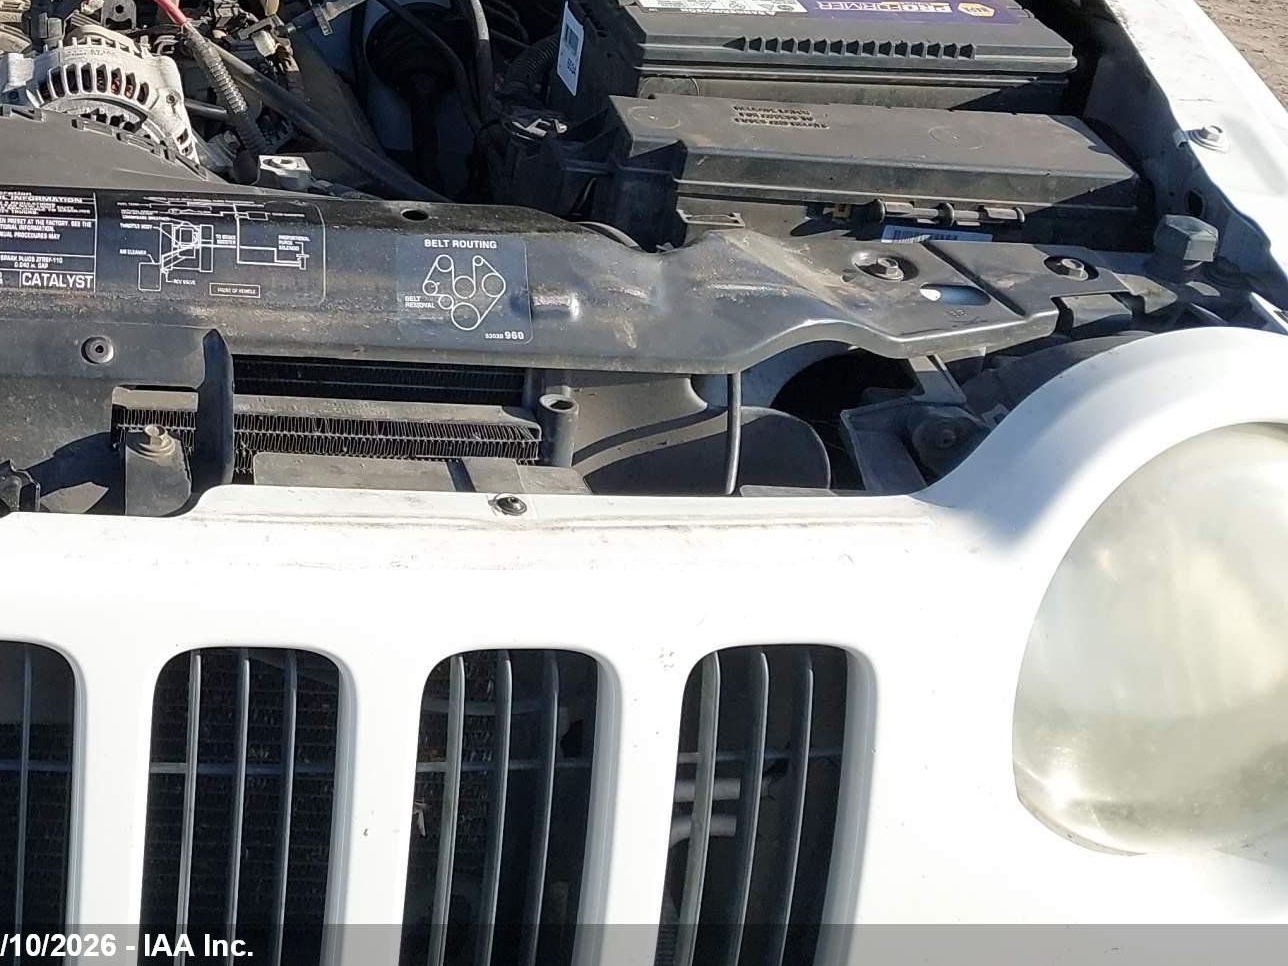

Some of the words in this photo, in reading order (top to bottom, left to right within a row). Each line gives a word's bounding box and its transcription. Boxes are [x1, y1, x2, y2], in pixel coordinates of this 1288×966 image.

[11, 195, 83, 203] INFORMATION
[424, 239, 449, 248] BELT
[452, 239, 498, 249] ROUTING
[22, 273, 94, 288] CATALYST
